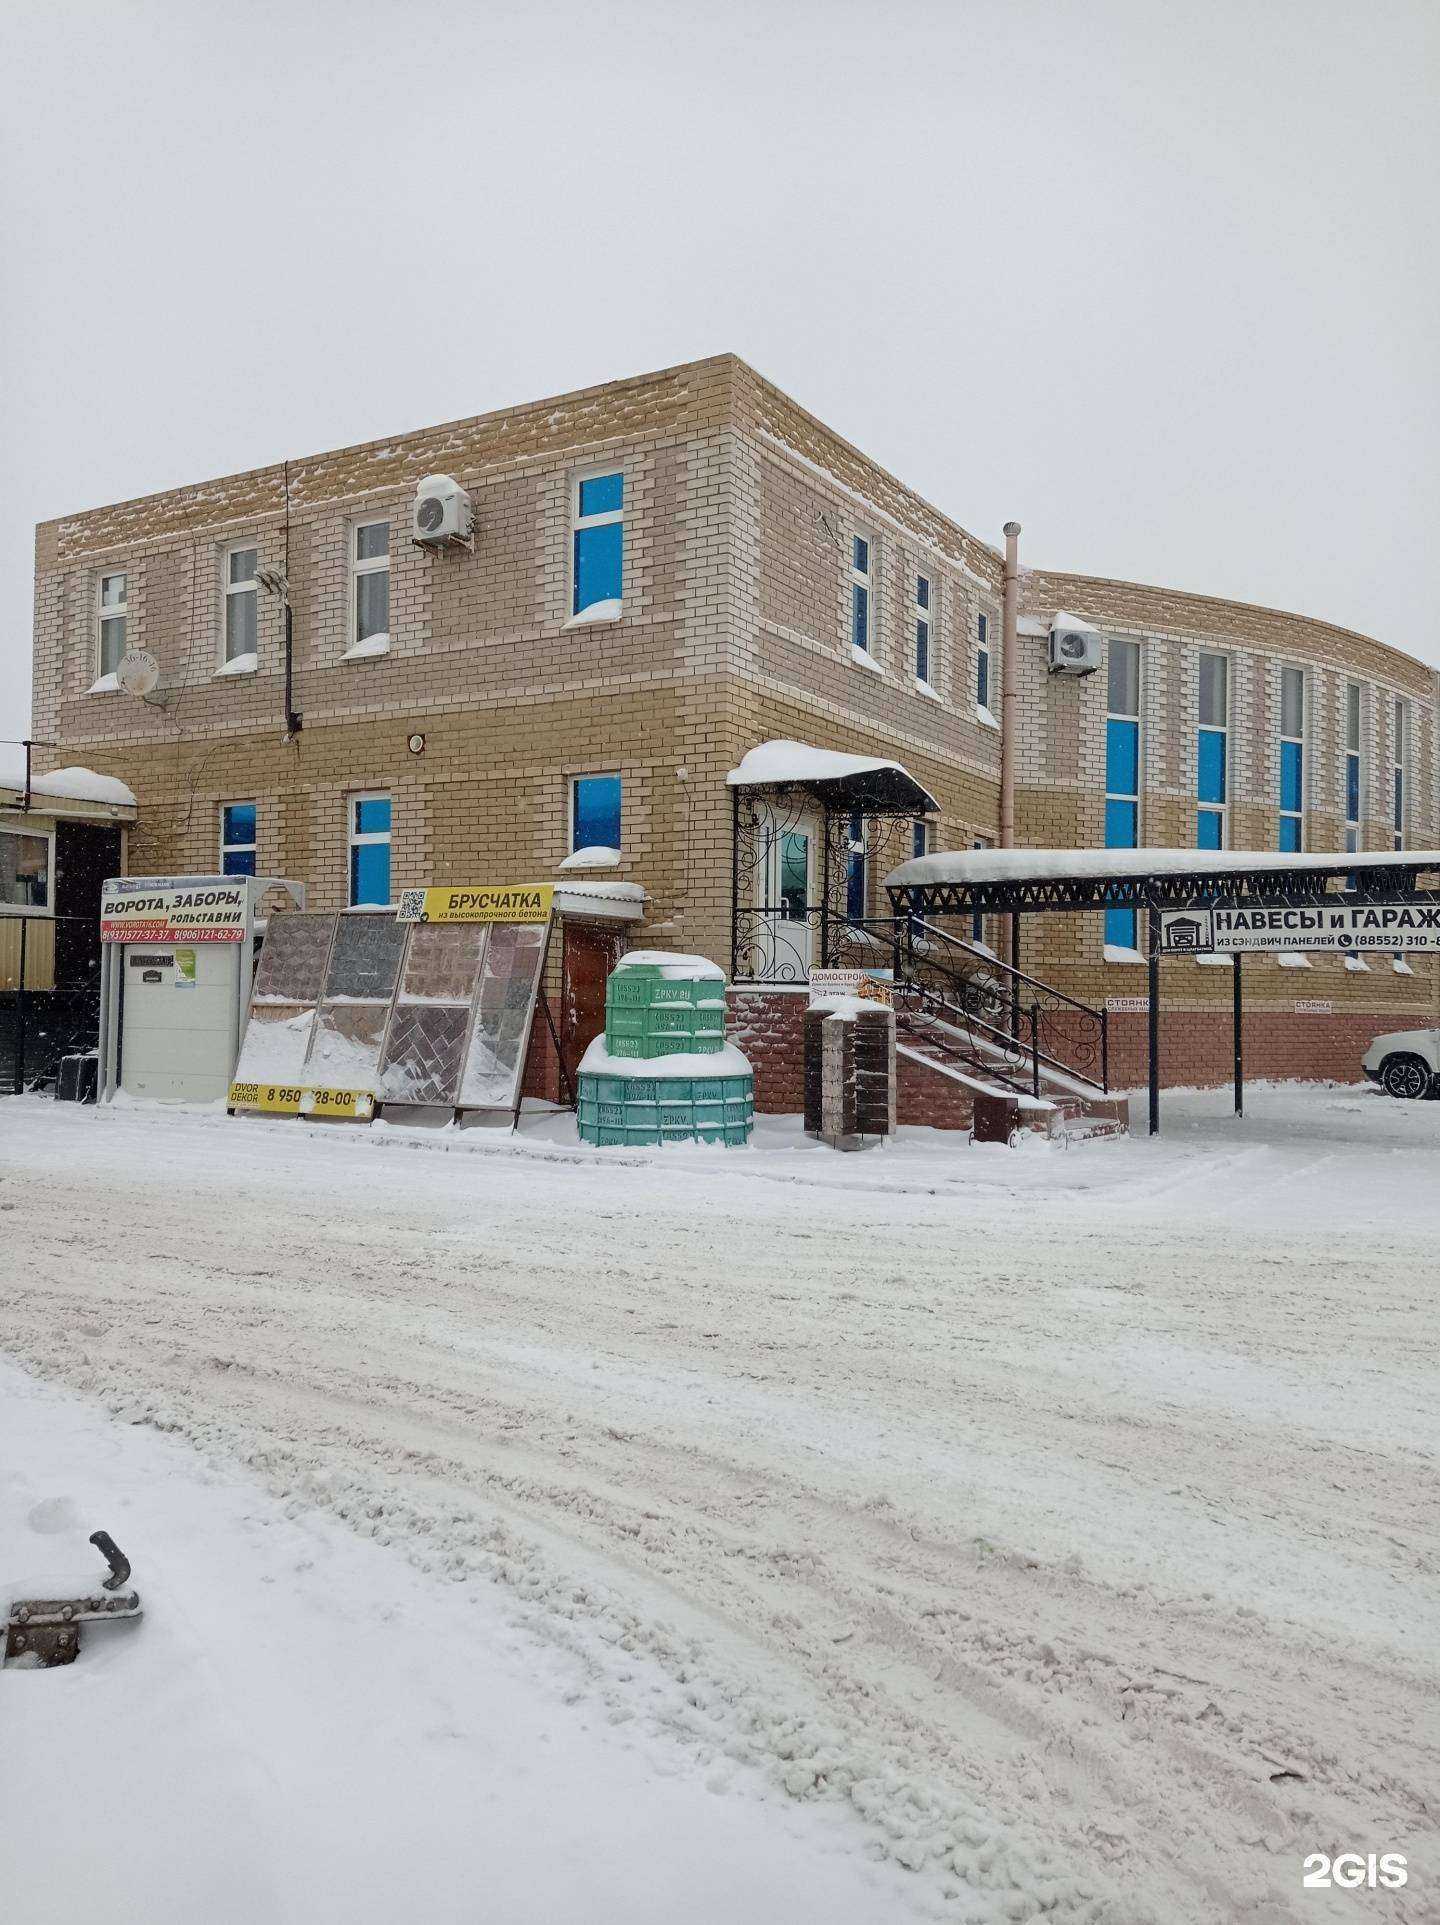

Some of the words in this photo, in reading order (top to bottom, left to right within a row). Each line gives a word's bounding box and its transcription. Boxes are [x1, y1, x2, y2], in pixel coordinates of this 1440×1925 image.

[104, 898, 170, 914] ВОРОТА,
[171, 891, 243, 908] ЗАБОРЫ,
[448, 892, 542, 909] БРУСЧАТКА
[170, 912, 242, 923] РОЛЬСТАВНИ
[449, 911, 517, 920] высокопрочного
[518, 908, 548, 918] бетона
[1216, 911, 1323, 930] НАВЕСЫ
[1330, 914, 1344, 929] и
[173, 930, 243, 940] 8(906)121-62-79
[1217, 938, 1231, 946] ИЗ
[1233, 937, 1281, 947] СЭНДВИЧ
[1283, 934, 1335, 945] ПАНЕЛЕЙ
[1355, 935, 1403, 946] (88552)
[1406, 936, 1427, 945] 310
[812, 973, 865, 982] ДОМОСТРОЙ
[235, 1083, 259, 1093] DVOR
[231, 1092, 258, 1102] DEKOR
[267, 1088, 276, 1101] 8
[279, 1089, 301, 1102] 950
